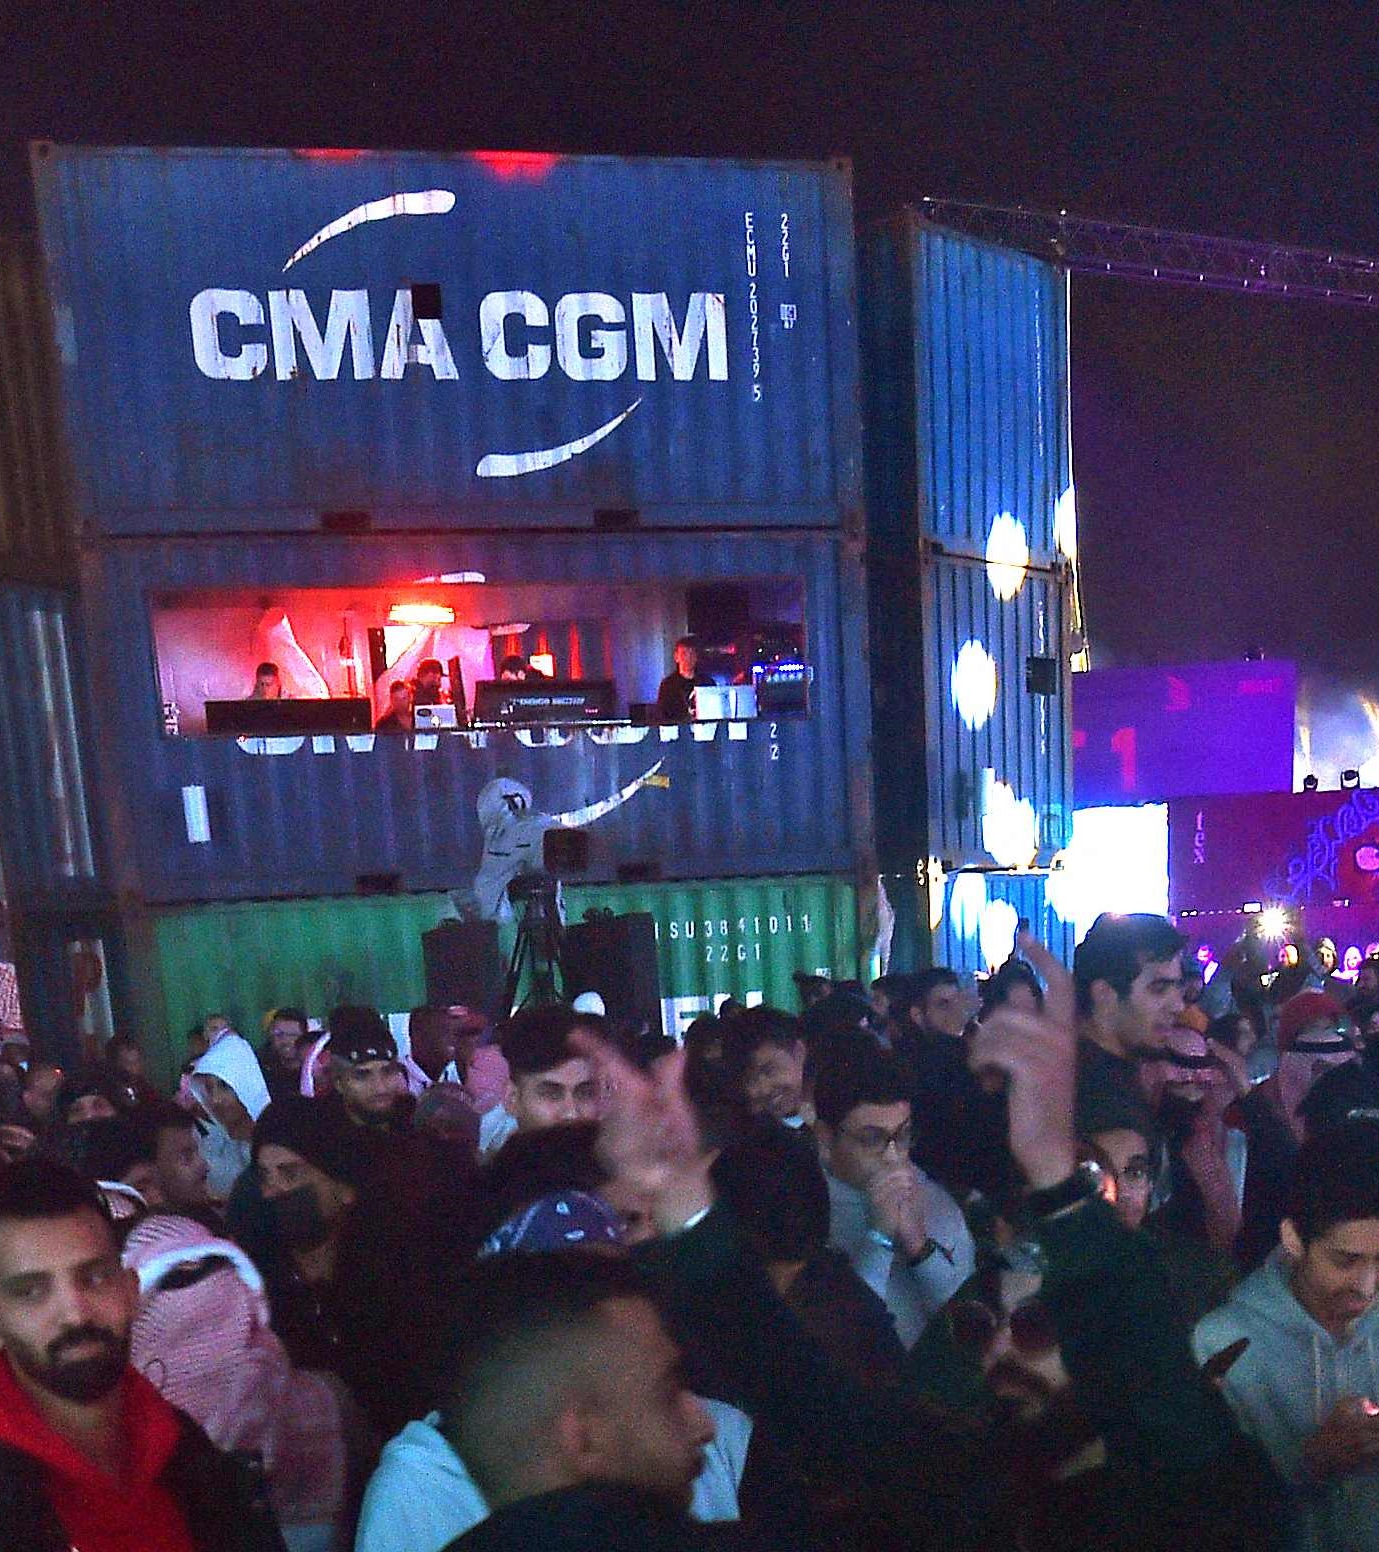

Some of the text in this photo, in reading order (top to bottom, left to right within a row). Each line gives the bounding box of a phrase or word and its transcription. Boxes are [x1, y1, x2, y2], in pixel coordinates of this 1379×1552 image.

[744, 211, 757, 278] ECMU
[780, 212, 791, 279] 22G1
[188, 287, 729, 381] CMA CGM
[706, 943, 762, 962] 22G1
